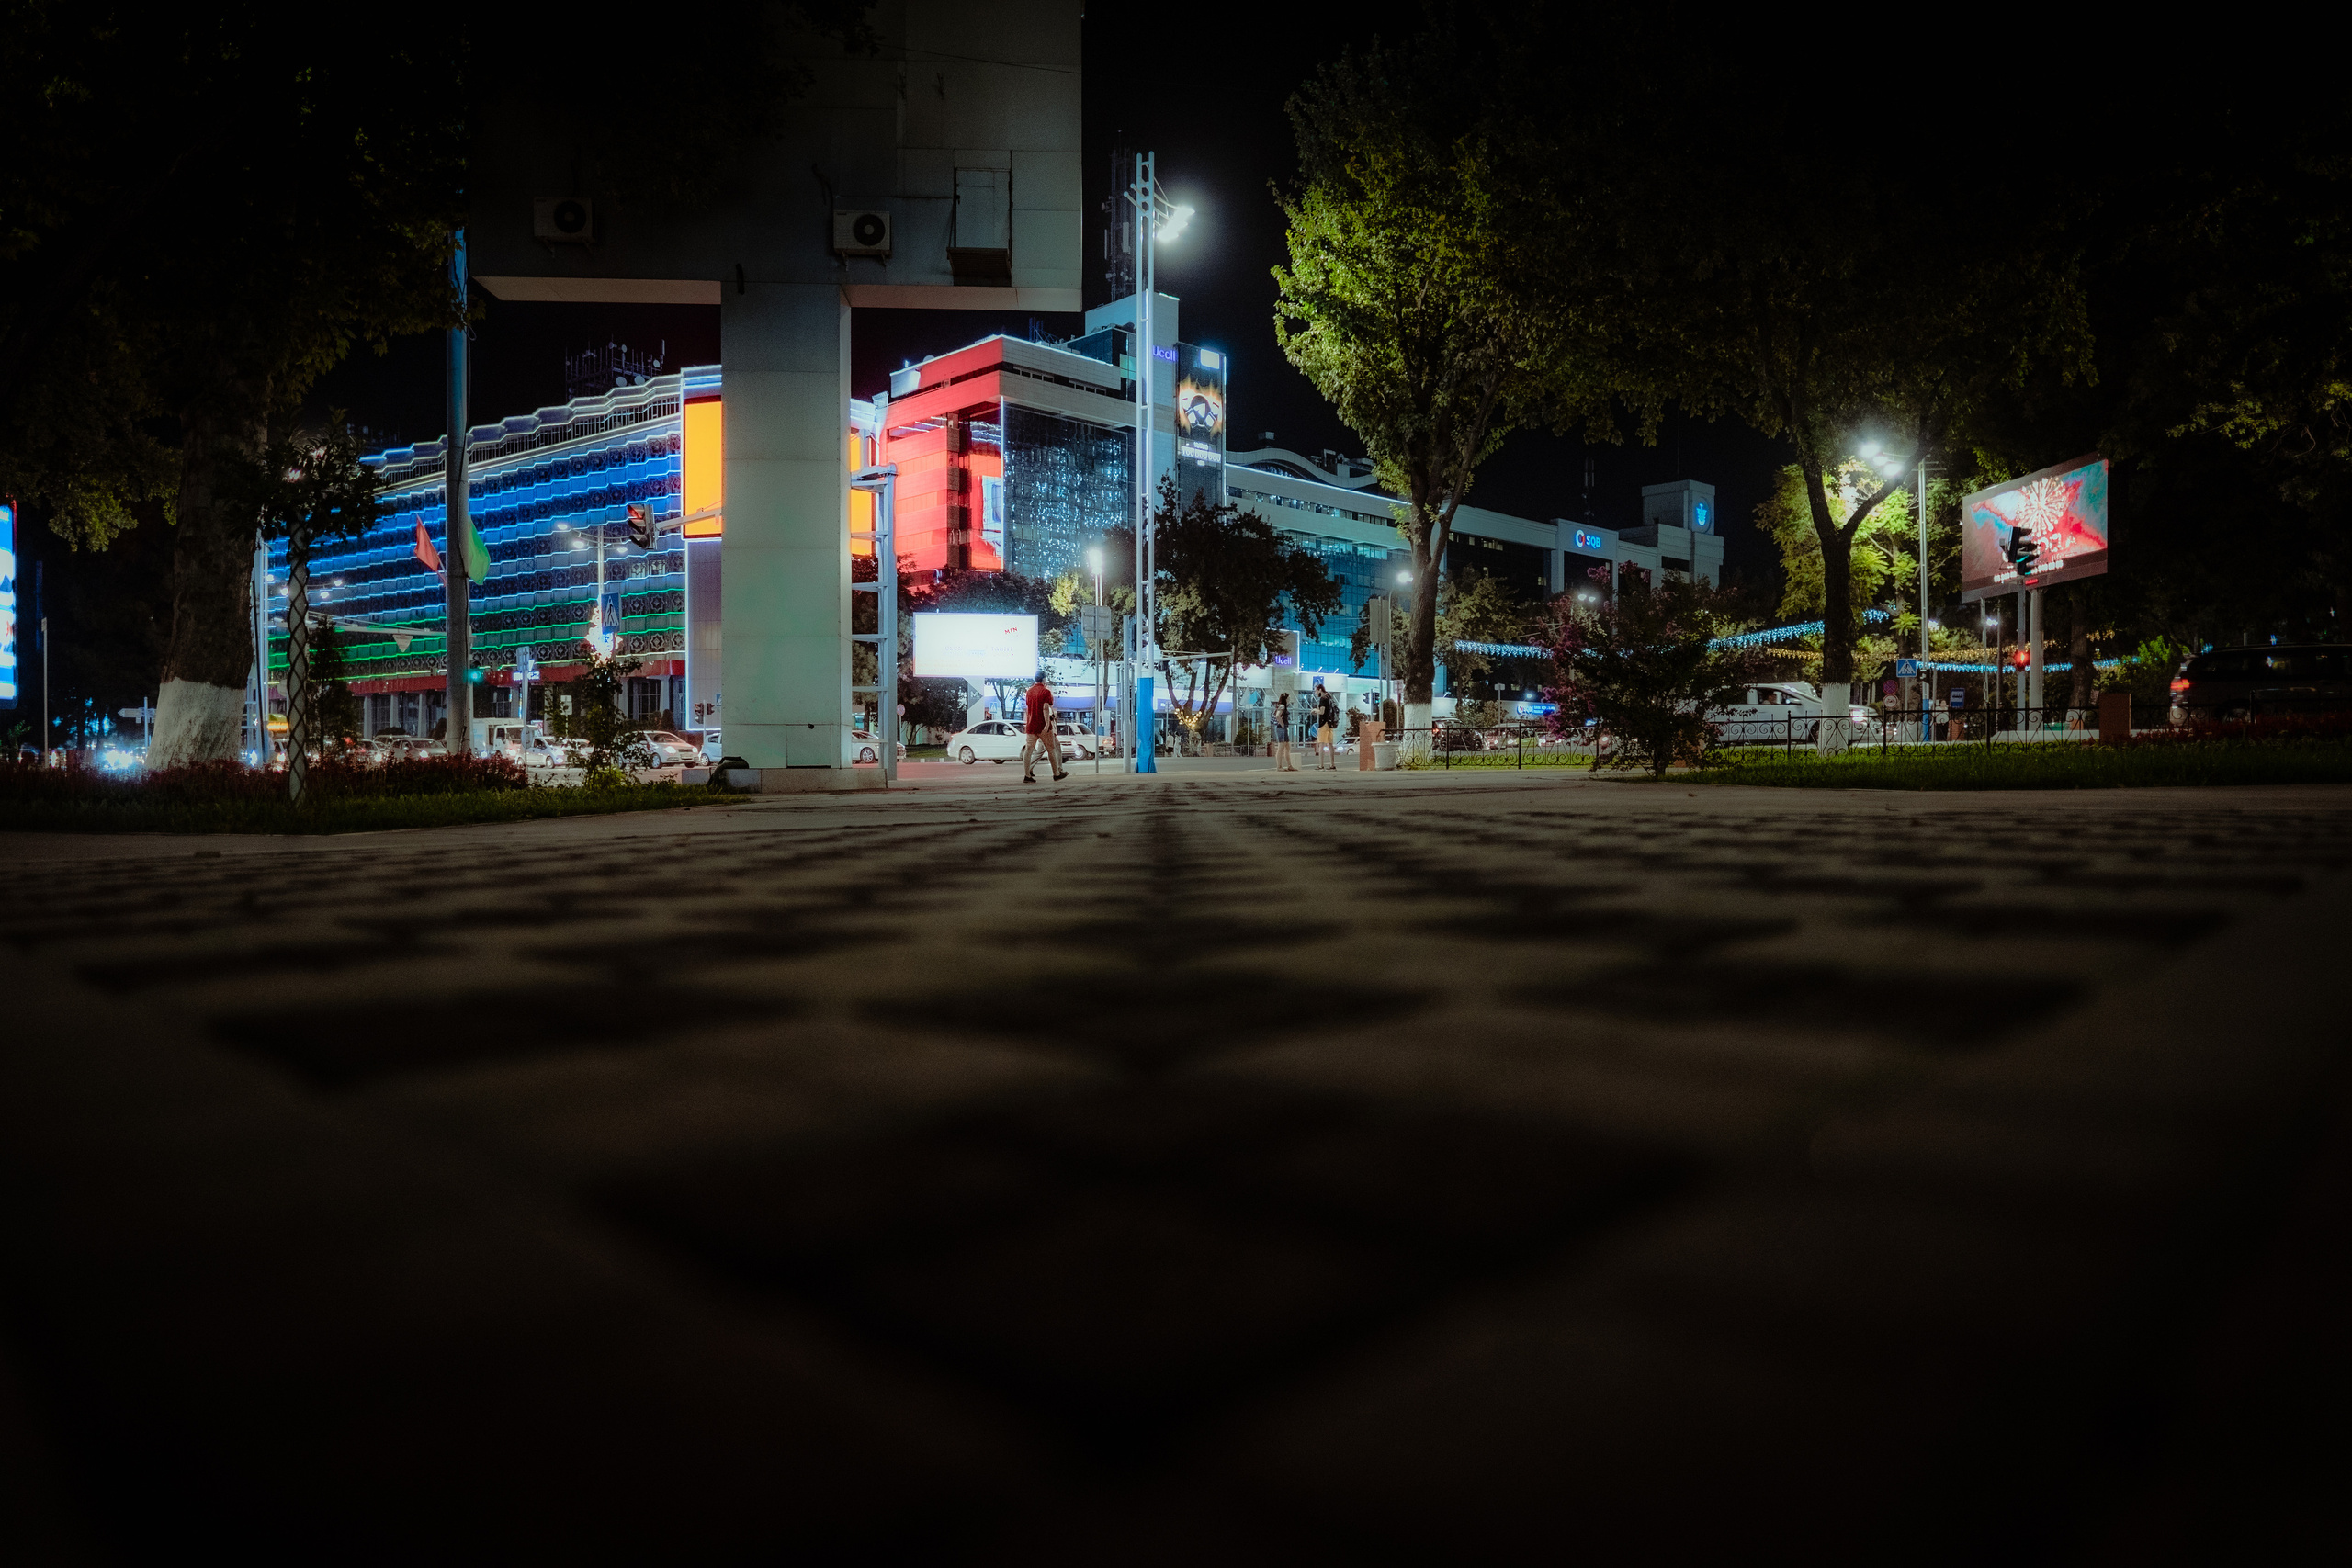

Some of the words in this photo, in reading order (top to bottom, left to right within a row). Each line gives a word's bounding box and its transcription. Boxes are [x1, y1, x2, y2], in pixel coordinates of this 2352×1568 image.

[1152, 344, 1176, 361] Ucell
[1586, 535, 1601, 549] SQB
[1004, 626, 1018, 635] MIN
[1275, 656, 1292, 665] Ucell
